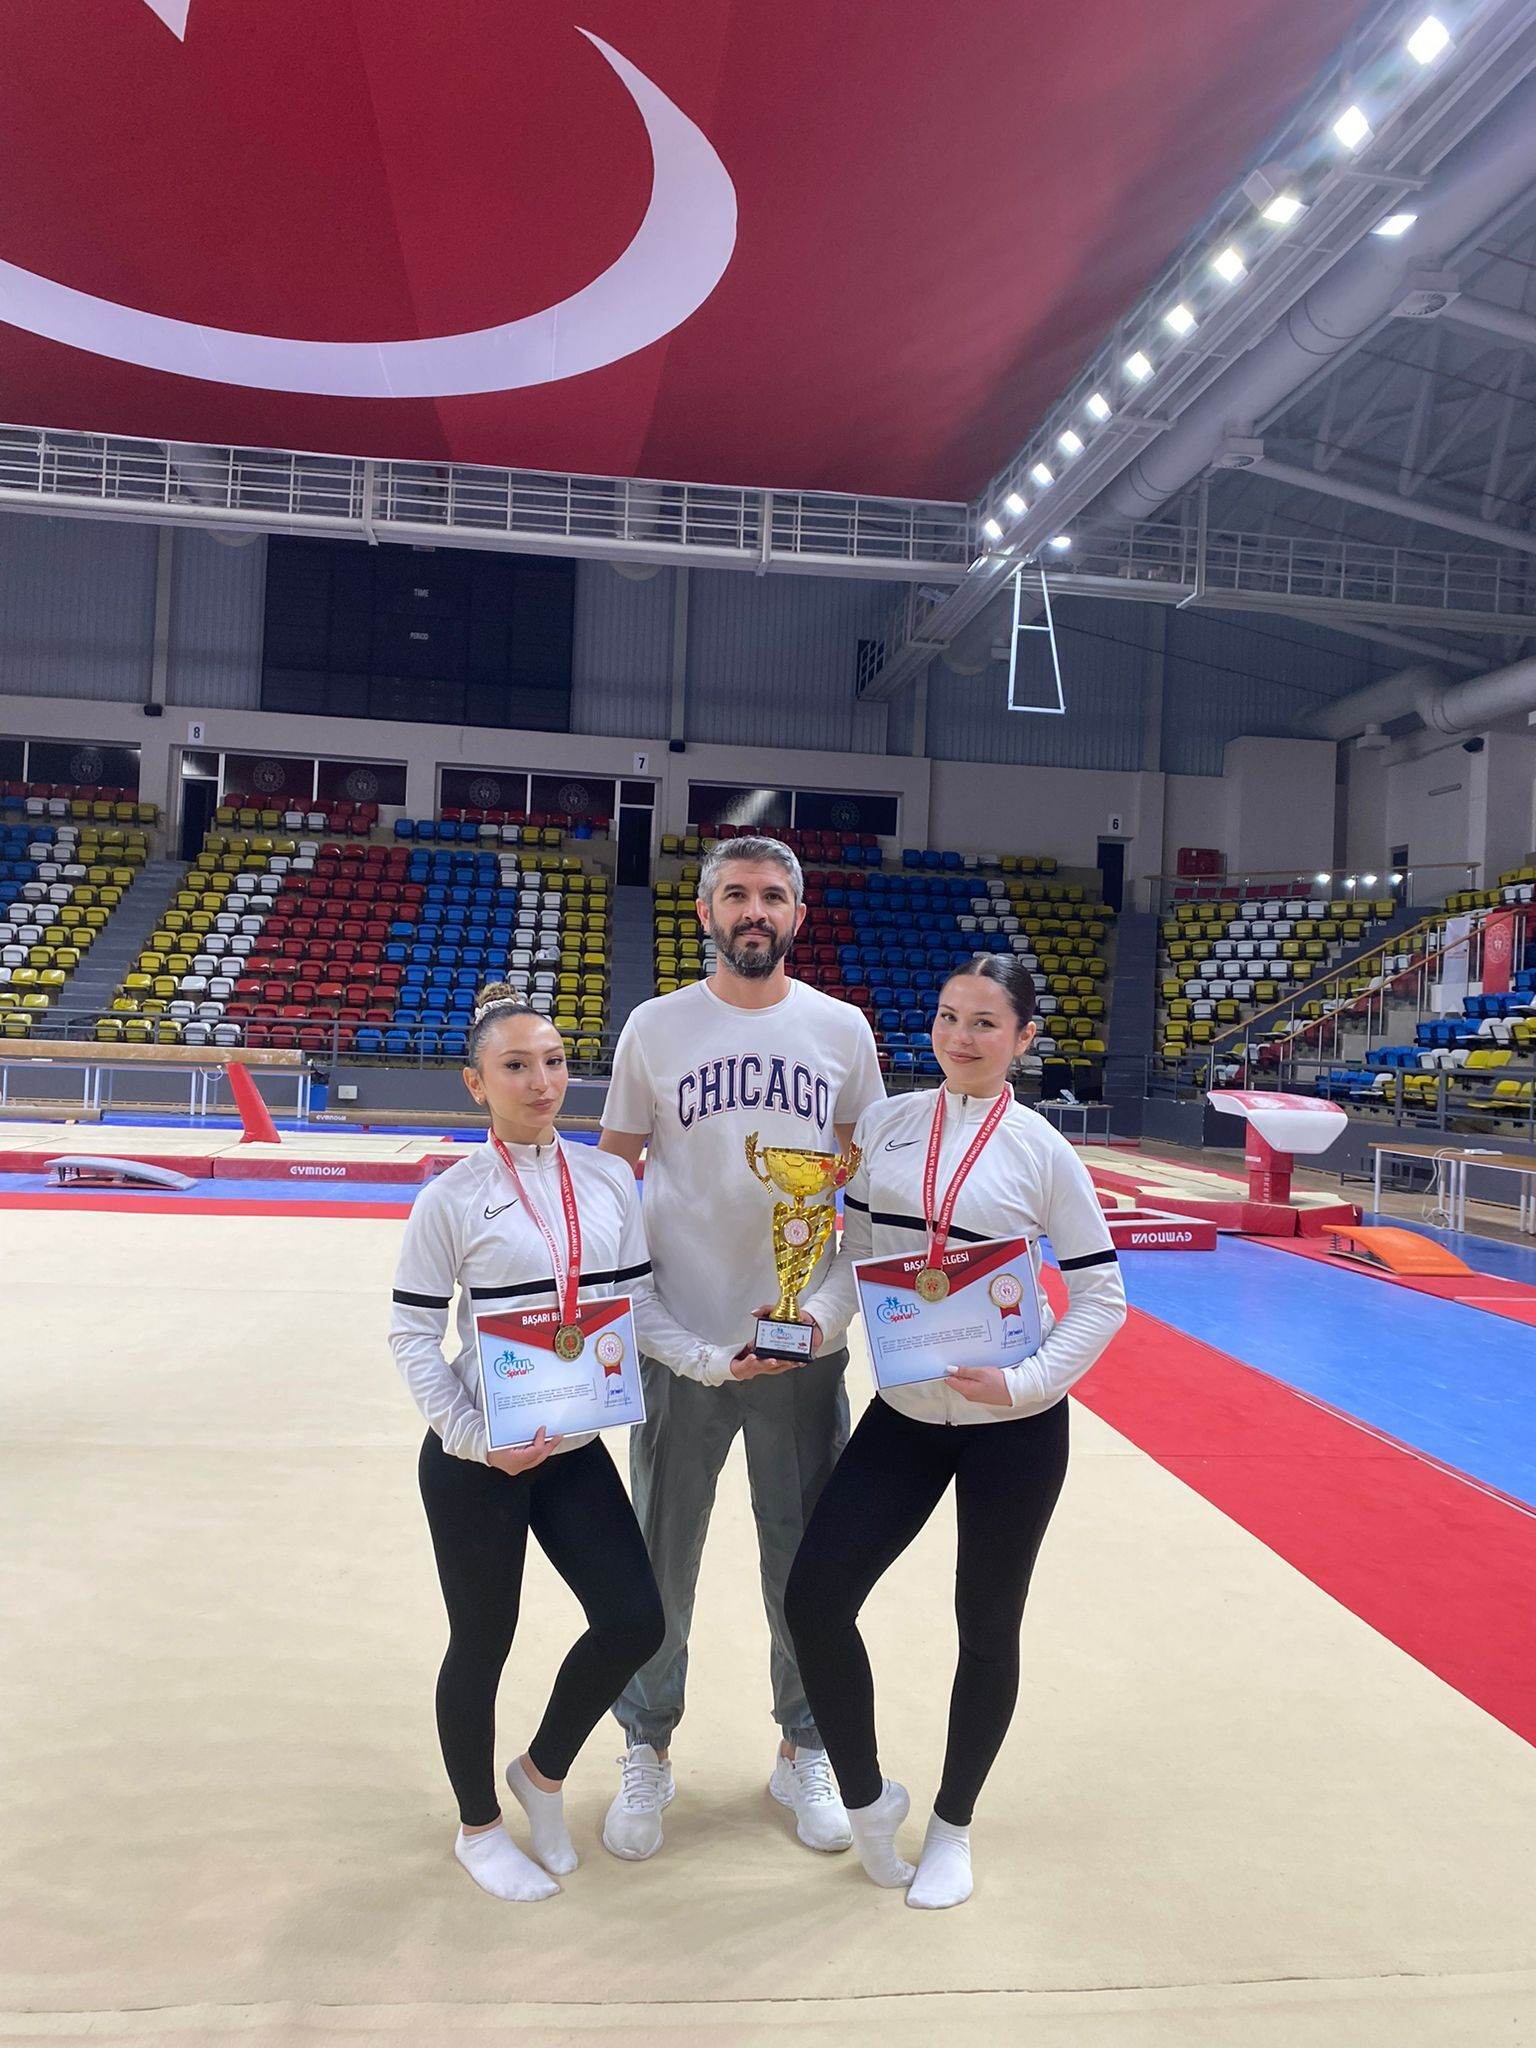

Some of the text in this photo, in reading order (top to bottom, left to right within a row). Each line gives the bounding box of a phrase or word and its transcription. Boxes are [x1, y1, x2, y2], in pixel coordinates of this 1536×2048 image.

[193, 726, 201, 739] 8
[638, 757, 646, 769] 7
[1112, 818, 1119, 830] 6
[676, 1053, 830, 1135] CHICAGO
[290, 1165, 346, 1176] GYMNOVA
[903, 1251, 970, 1272] BAŞA ELGESİ
[521, 1312, 550, 1326] BAŞARI
